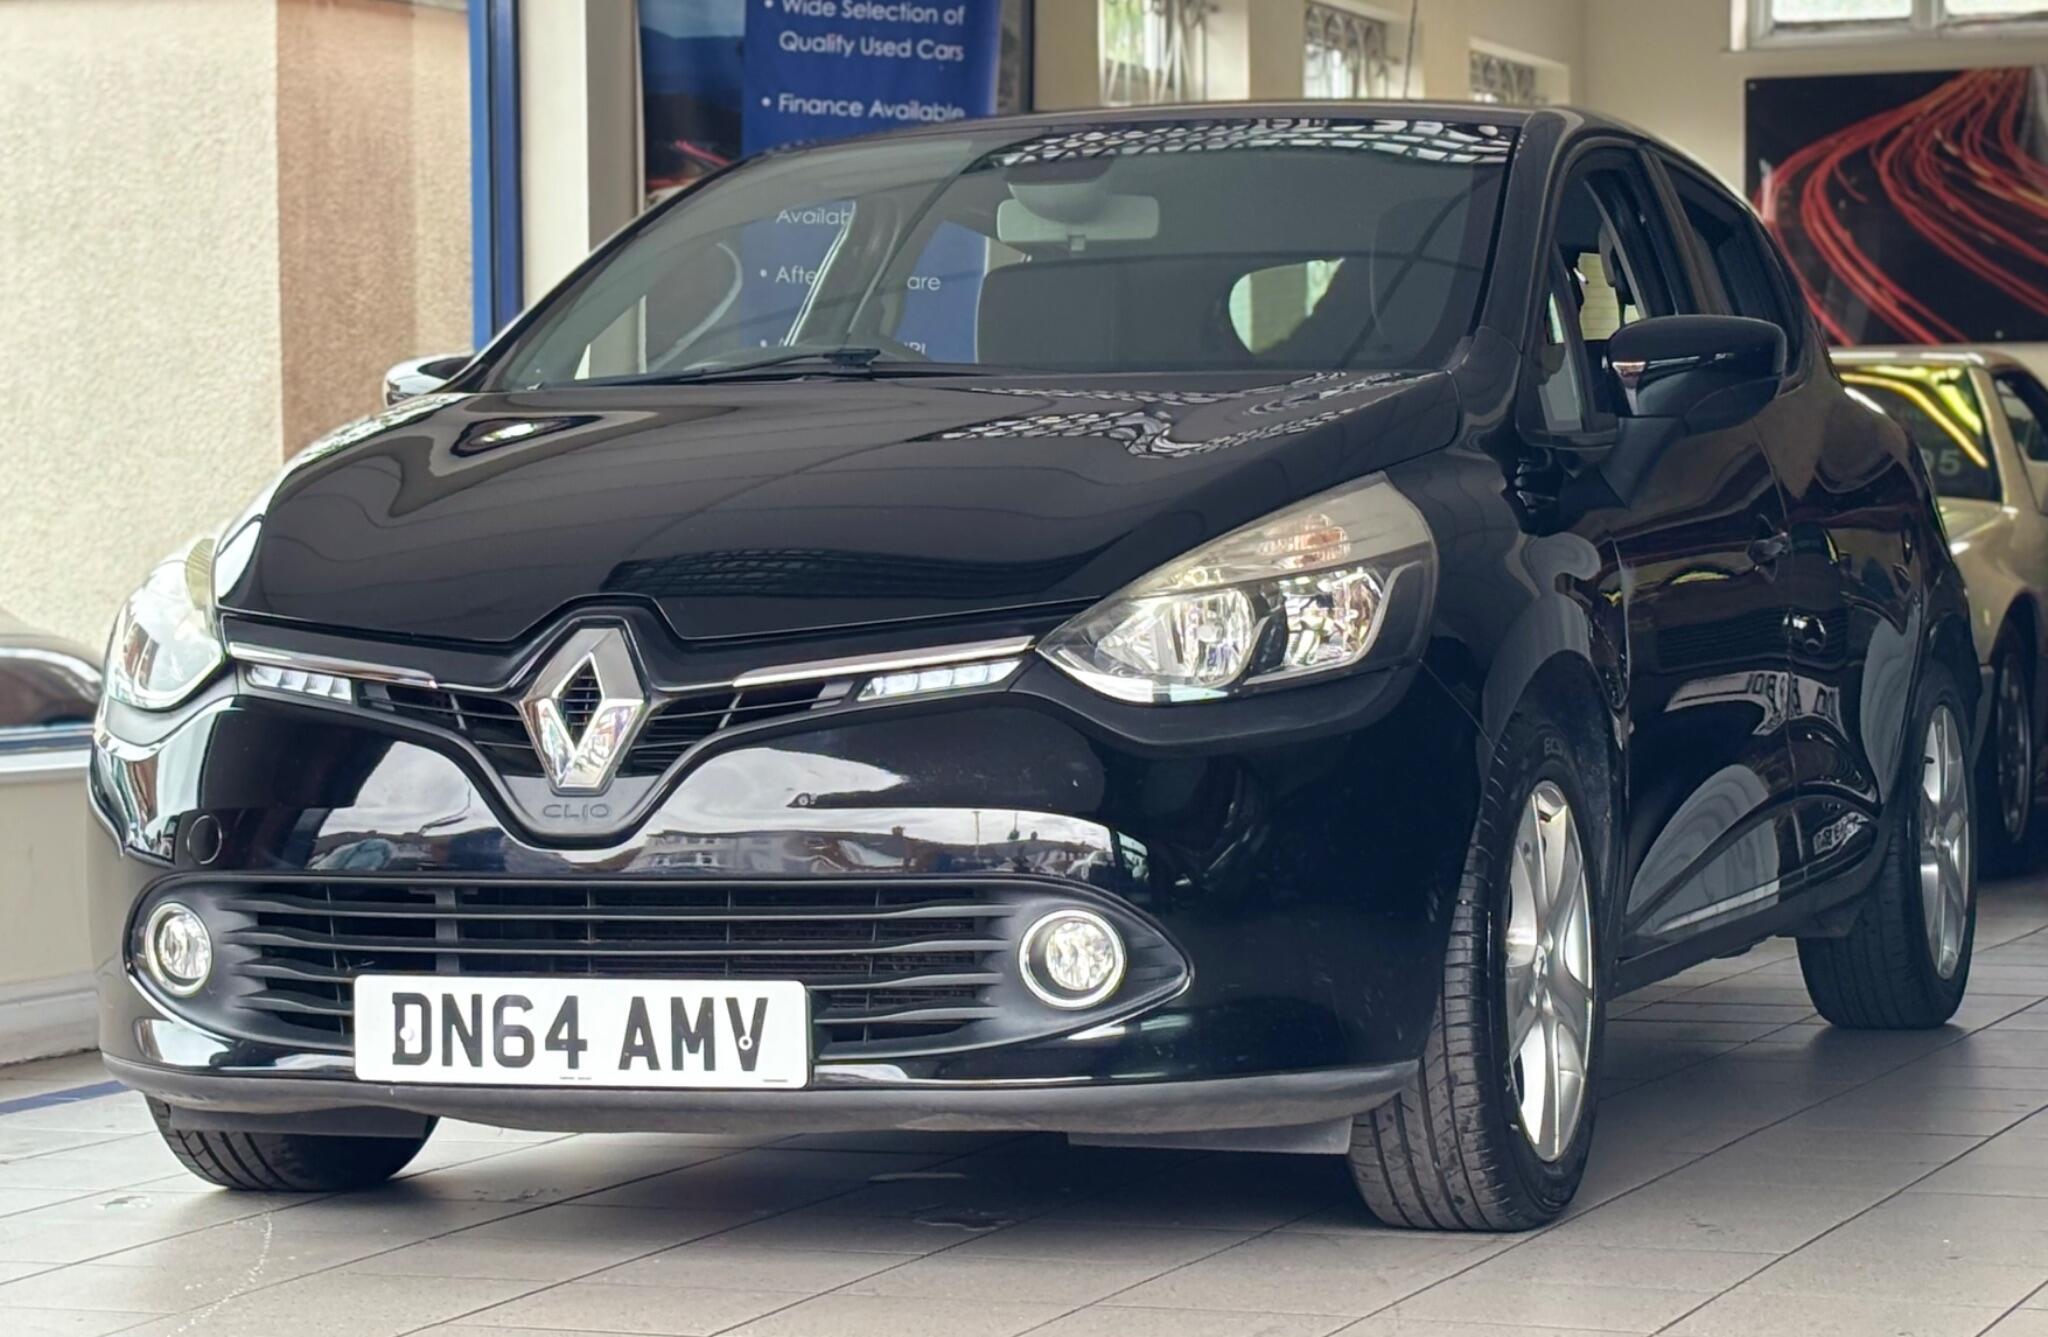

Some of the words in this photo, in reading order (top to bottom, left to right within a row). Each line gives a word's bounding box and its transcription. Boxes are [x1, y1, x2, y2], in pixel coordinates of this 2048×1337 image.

[782, 0, 837, 17] Wide
[842, 0, 938, 24] Selection
[943, 5, 966, 25] of
[779, 30, 855, 58] Quality
[860, 36, 912, 58] Used
[917, 38, 965, 61] Cars
[778, 93, 864, 117] Finance
[868, 99, 966, 122] Available
[776, 207, 851, 225] Availab
[775, 265, 818, 285] Afte
[906, 275, 941, 291] are
[542, 803, 611, 820] CLIO
[391, 991, 589, 1070] DN64
[617, 995, 770, 1073] AMV
